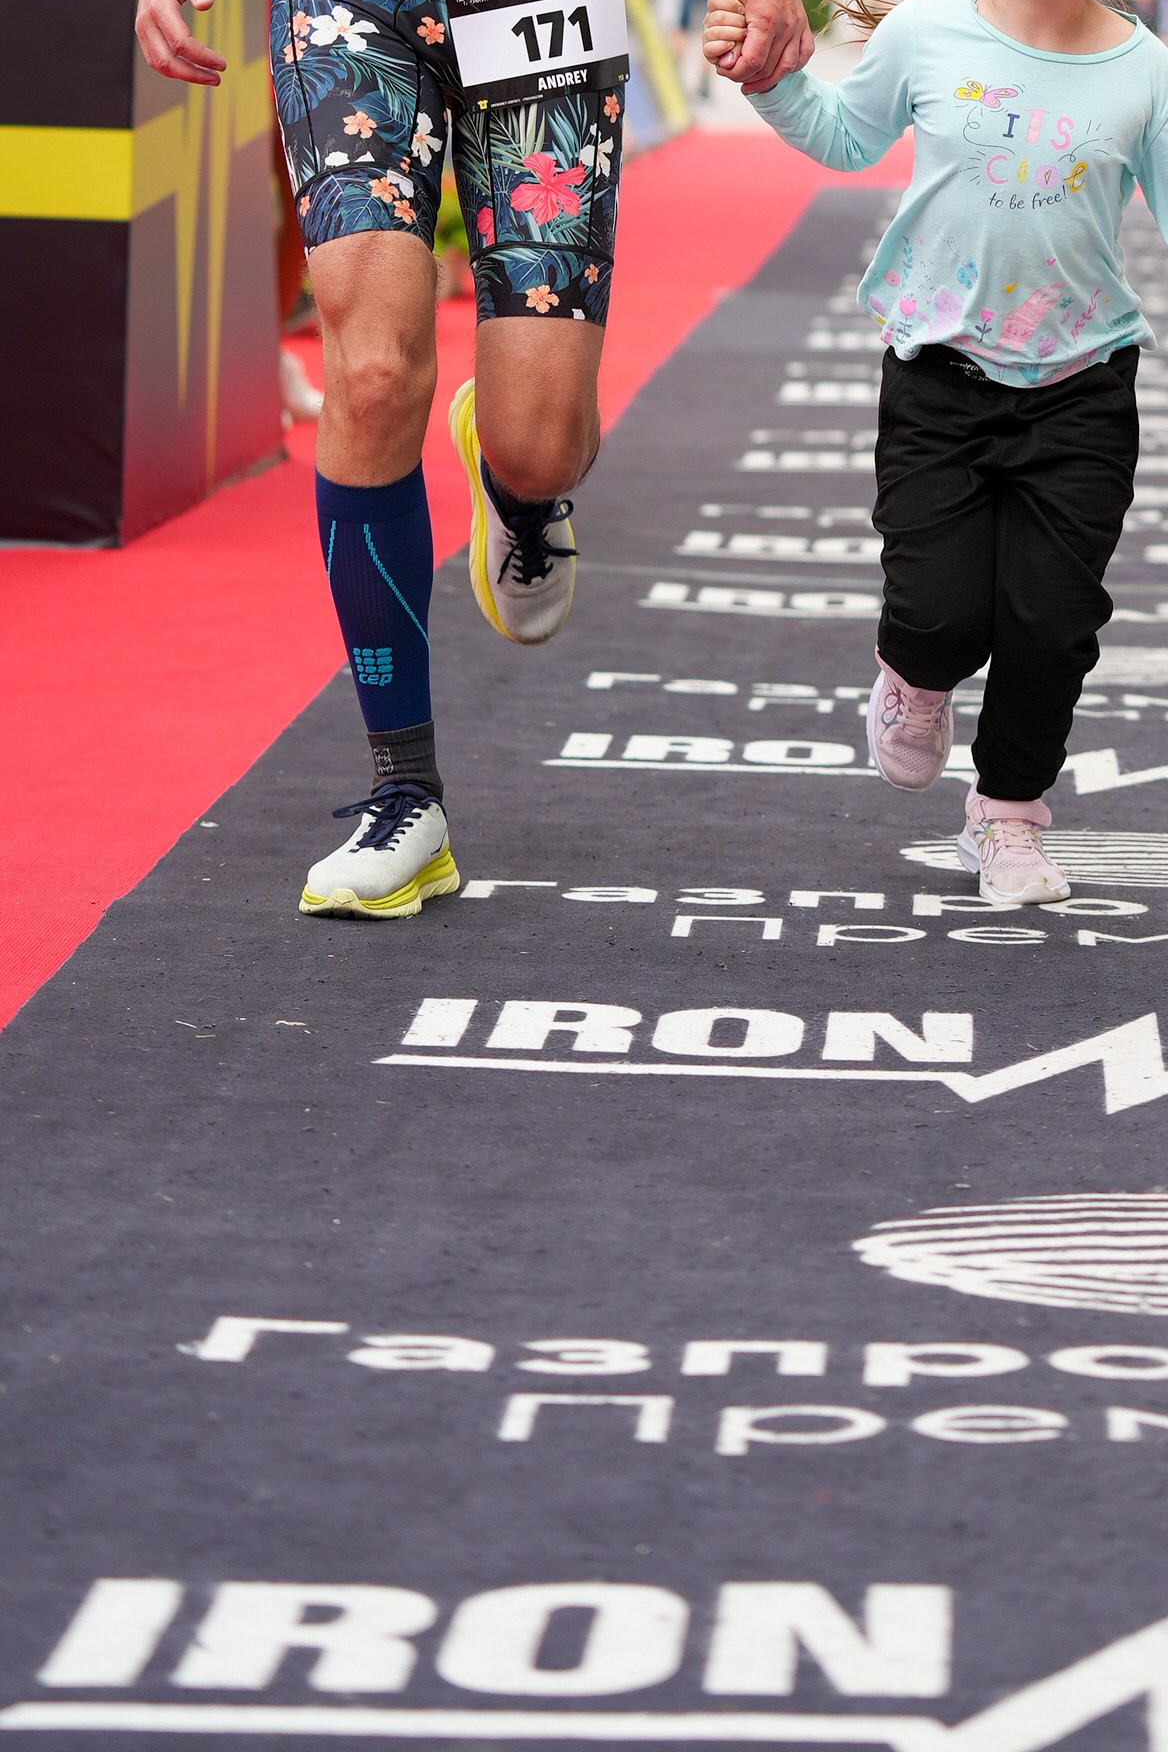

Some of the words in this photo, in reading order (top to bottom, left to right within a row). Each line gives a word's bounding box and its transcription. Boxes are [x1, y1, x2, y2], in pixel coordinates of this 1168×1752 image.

[511, 5, 594, 63] 171
[538, 68, 588, 91] ANDREY
[989, 192, 1004, 208] to
[1009, 194, 1025, 210] be
[1031, 184, 1067, 210] free!
[358, 673, 393, 686] cep
[401, 997, 974, 1063] IRON
[37, 1578, 952, 1697] IRON
